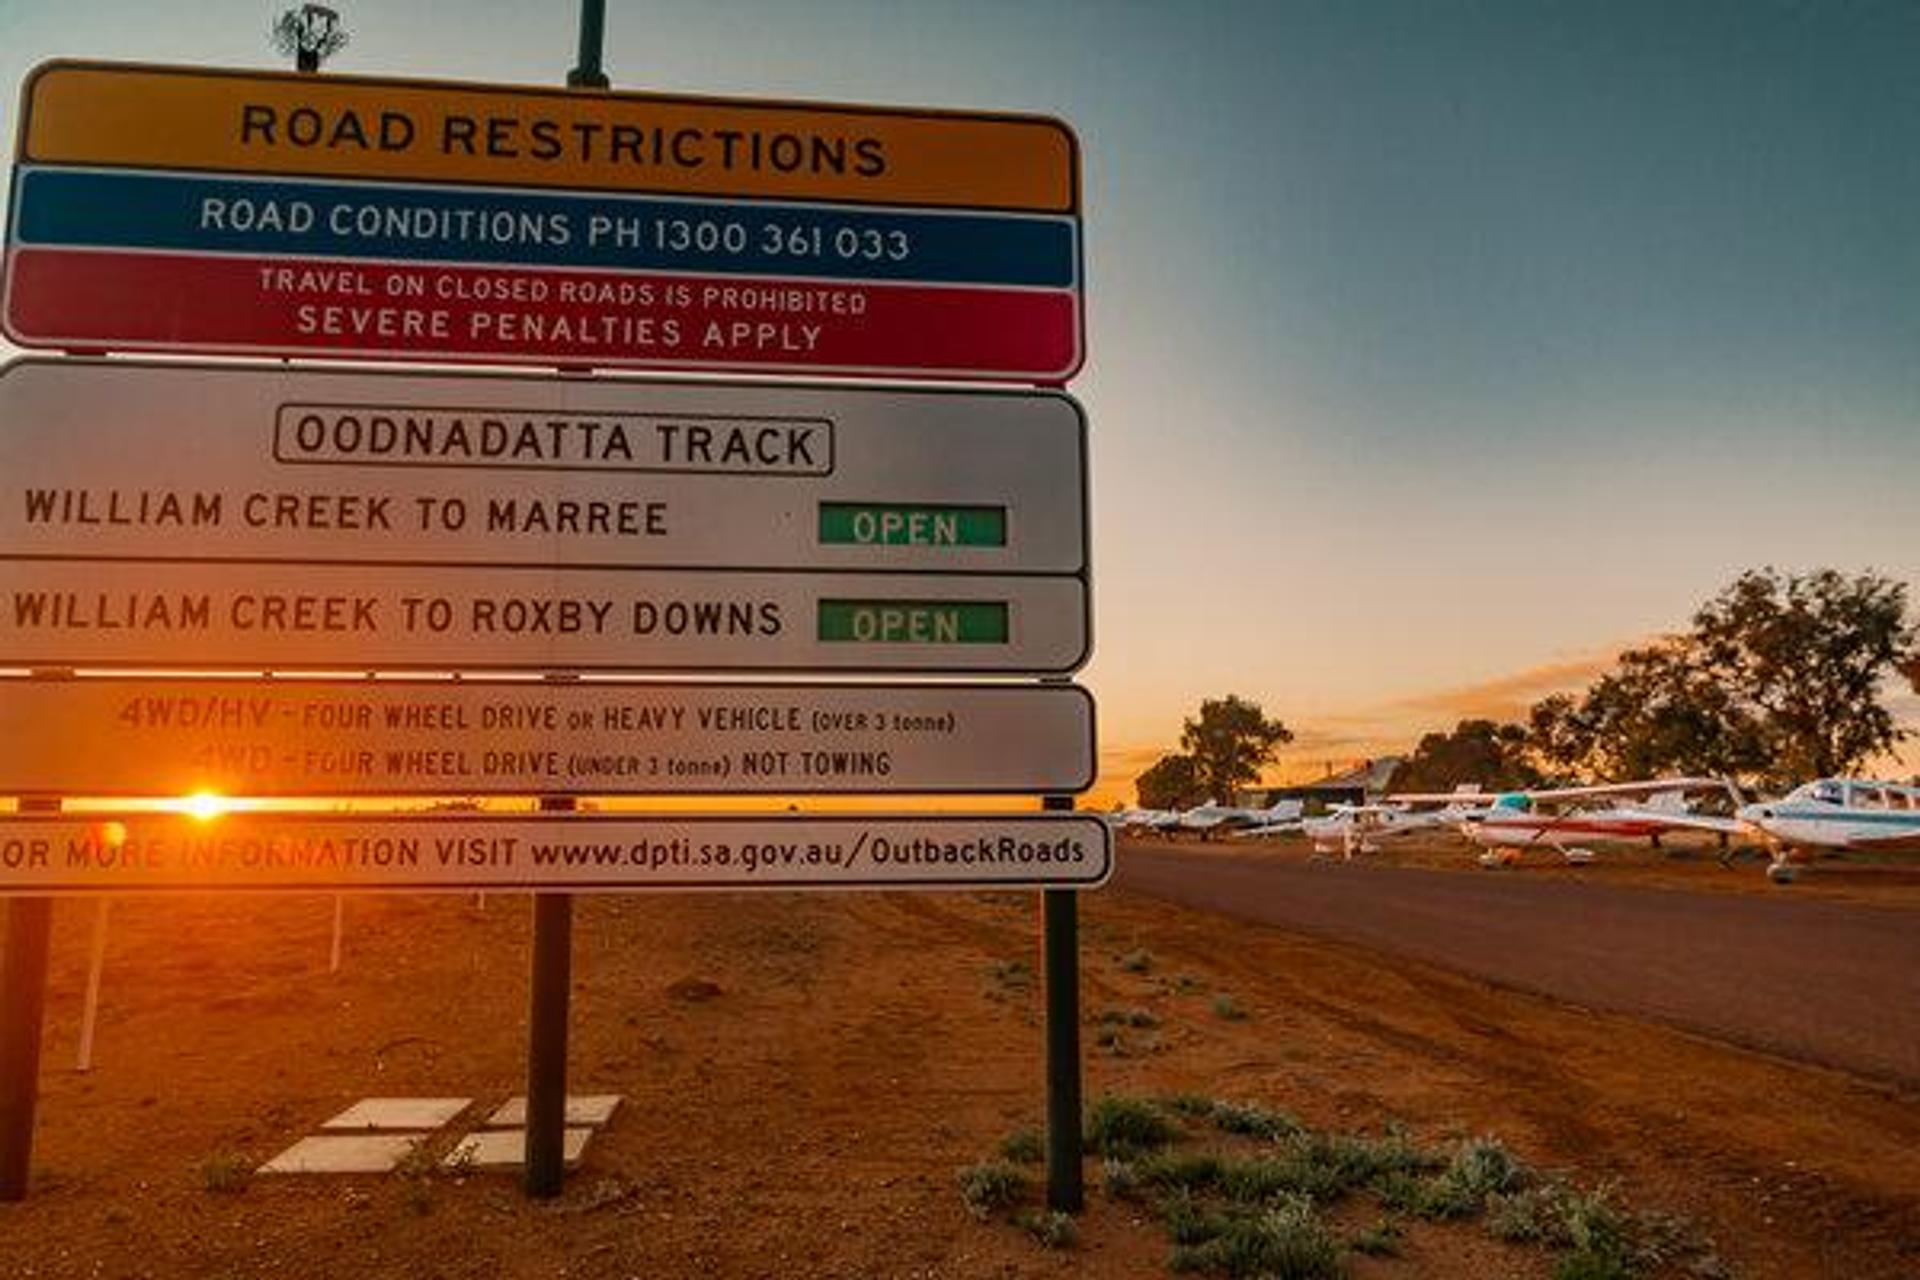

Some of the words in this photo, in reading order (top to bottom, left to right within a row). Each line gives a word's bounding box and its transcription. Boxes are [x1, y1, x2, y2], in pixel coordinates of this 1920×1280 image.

[241, 104, 415, 150] ROAD
[442, 116, 887, 177] RESTRICTIONS
[200, 199, 314, 233] ROAD
[330, 205, 571, 246] CONDITIONS
[588, 218, 641, 249] PH
[655, 220, 747, 253] 1300
[762, 224, 822, 257] 361
[835, 228, 910, 260] 033
[260, 268, 372, 296] TRAVEL
[386, 273, 424, 297] ON
[436, 276, 548, 302] CLOSED
[560, 282, 654, 306] ROADS
[666, 286, 691, 308] IS
[703, 288, 867, 314] PROHIBITED
[298, 307, 450, 338] SEVERE
[470, 312, 681, 346] PENALTIES
[703, 322, 822, 351] APPLY
[297, 415, 633, 460] OODNADATTA
[656, 424, 815, 467] TRACK
[24, 489, 221, 525] WILLIAM
[243, 493, 391, 530] CREEK
[416, 498, 466, 532] TO
[487, 499, 668, 536] MARREE
[853, 511, 958, 545] OPEN
[12, 593, 210, 629] WILLIAM
[230, 594, 379, 631] CREEK
[402, 598, 452, 632] TO
[472, 600, 613, 633] ROXBY
[633, 602, 783, 637] DOWNS
[852, 610, 960, 642] OPEN
[120, 698, 274, 730] 4WD/HV
[303, 705, 374, 730] FOUR
[385, 706, 470, 731] WHEEL
[482, 707, 557, 731] DRIVE
[567, 712, 594, 731] OR
[603, 706, 686, 732] HEAVY
[698, 707, 803, 732] VEHICLE
[811, 711, 869, 733] (OVER
[875, 712, 887, 732] 3
[894, 711, 956, 734] tonne)
[303, 752, 374, 777] FOUR
[386, 752, 471, 777] WHEEL
[483, 752, 559, 777] DRIVE
[567, 755, 639, 778] (UNDER
[647, 756, 660, 777] 3
[667, 756, 731, 778] tonne)
[741, 752, 788, 776] NOT
[802, 752, 892, 777] TOWING
[65, 839, 164, 868] MORE
[178, 839, 420, 867] INFORMATION
[434, 839, 519, 867] VISIT
[530, 832, 1085, 872] www.dpti.sa.gov.au/OutbackRoads
